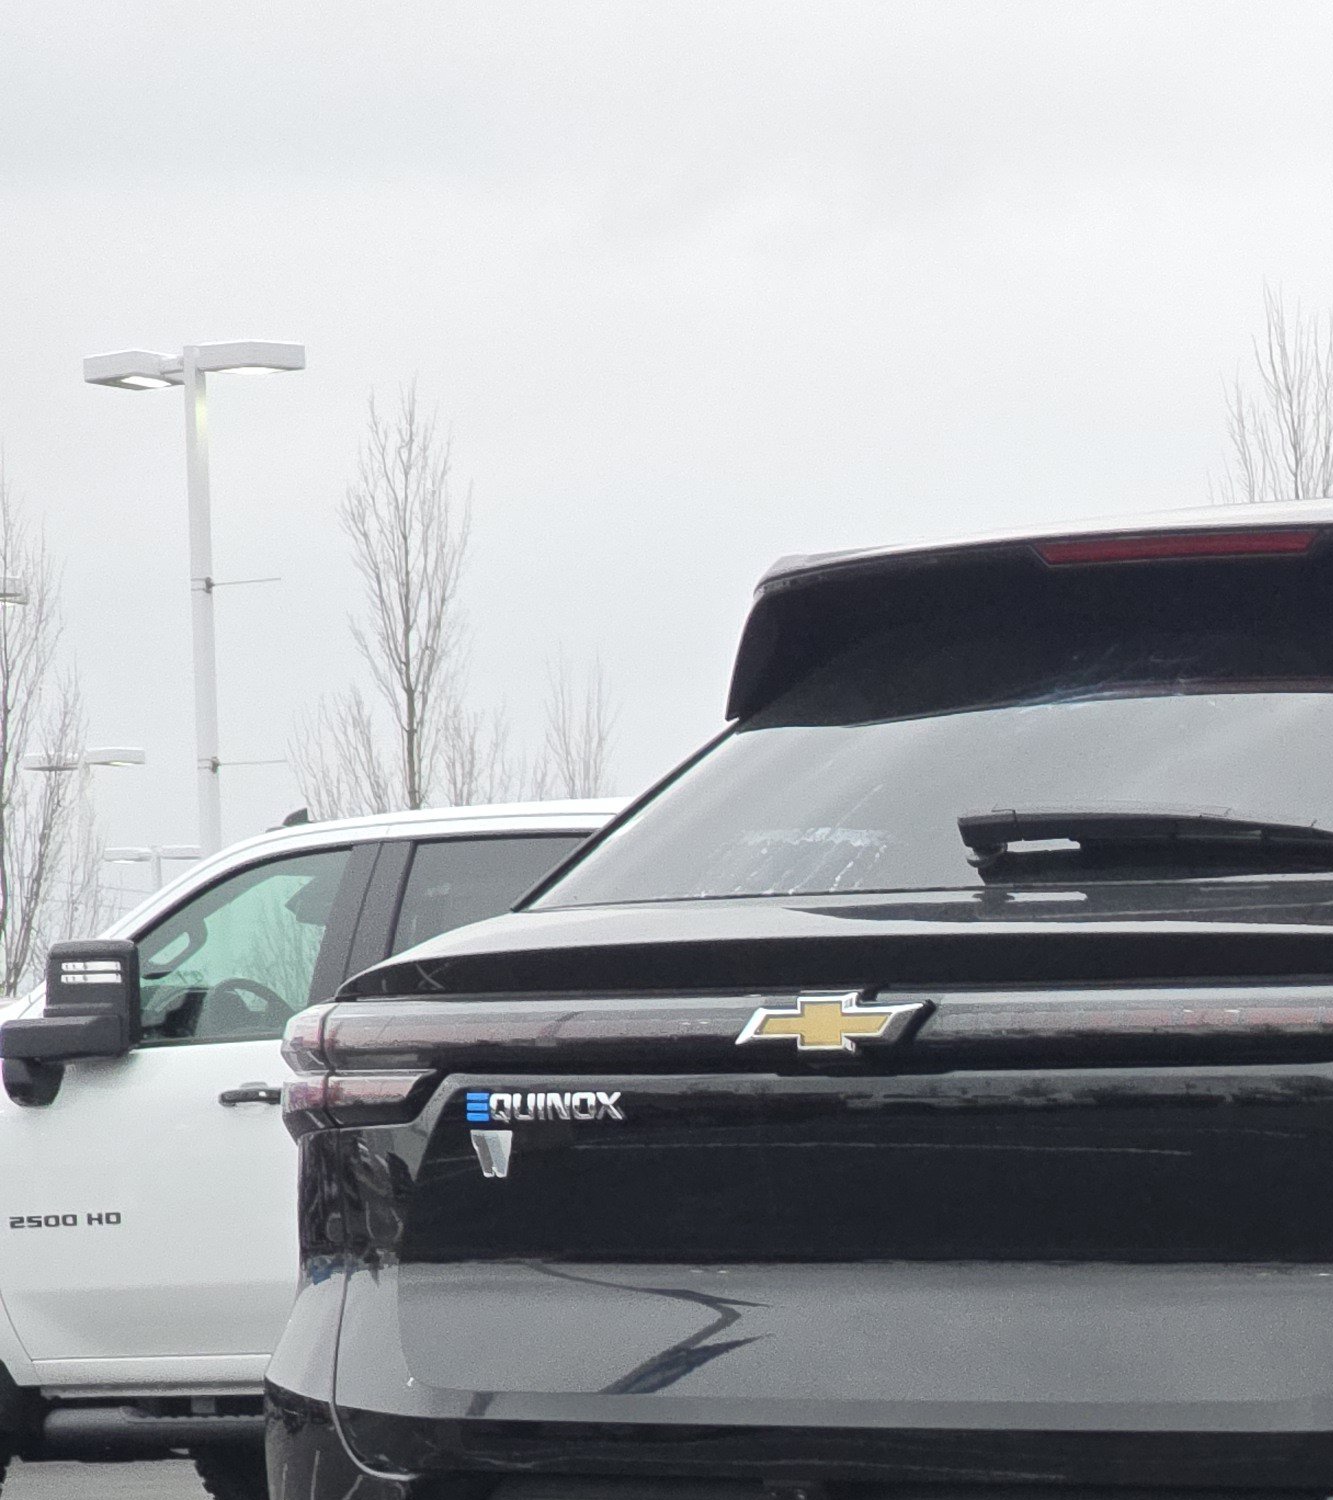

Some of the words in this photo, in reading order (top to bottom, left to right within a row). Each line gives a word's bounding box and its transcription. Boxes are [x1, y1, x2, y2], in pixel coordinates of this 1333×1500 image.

[466, 1092, 625, 1123] EQUINOX
[9, 1214, 78, 1229] 2500
[86, 1212, 121, 1226] HD
